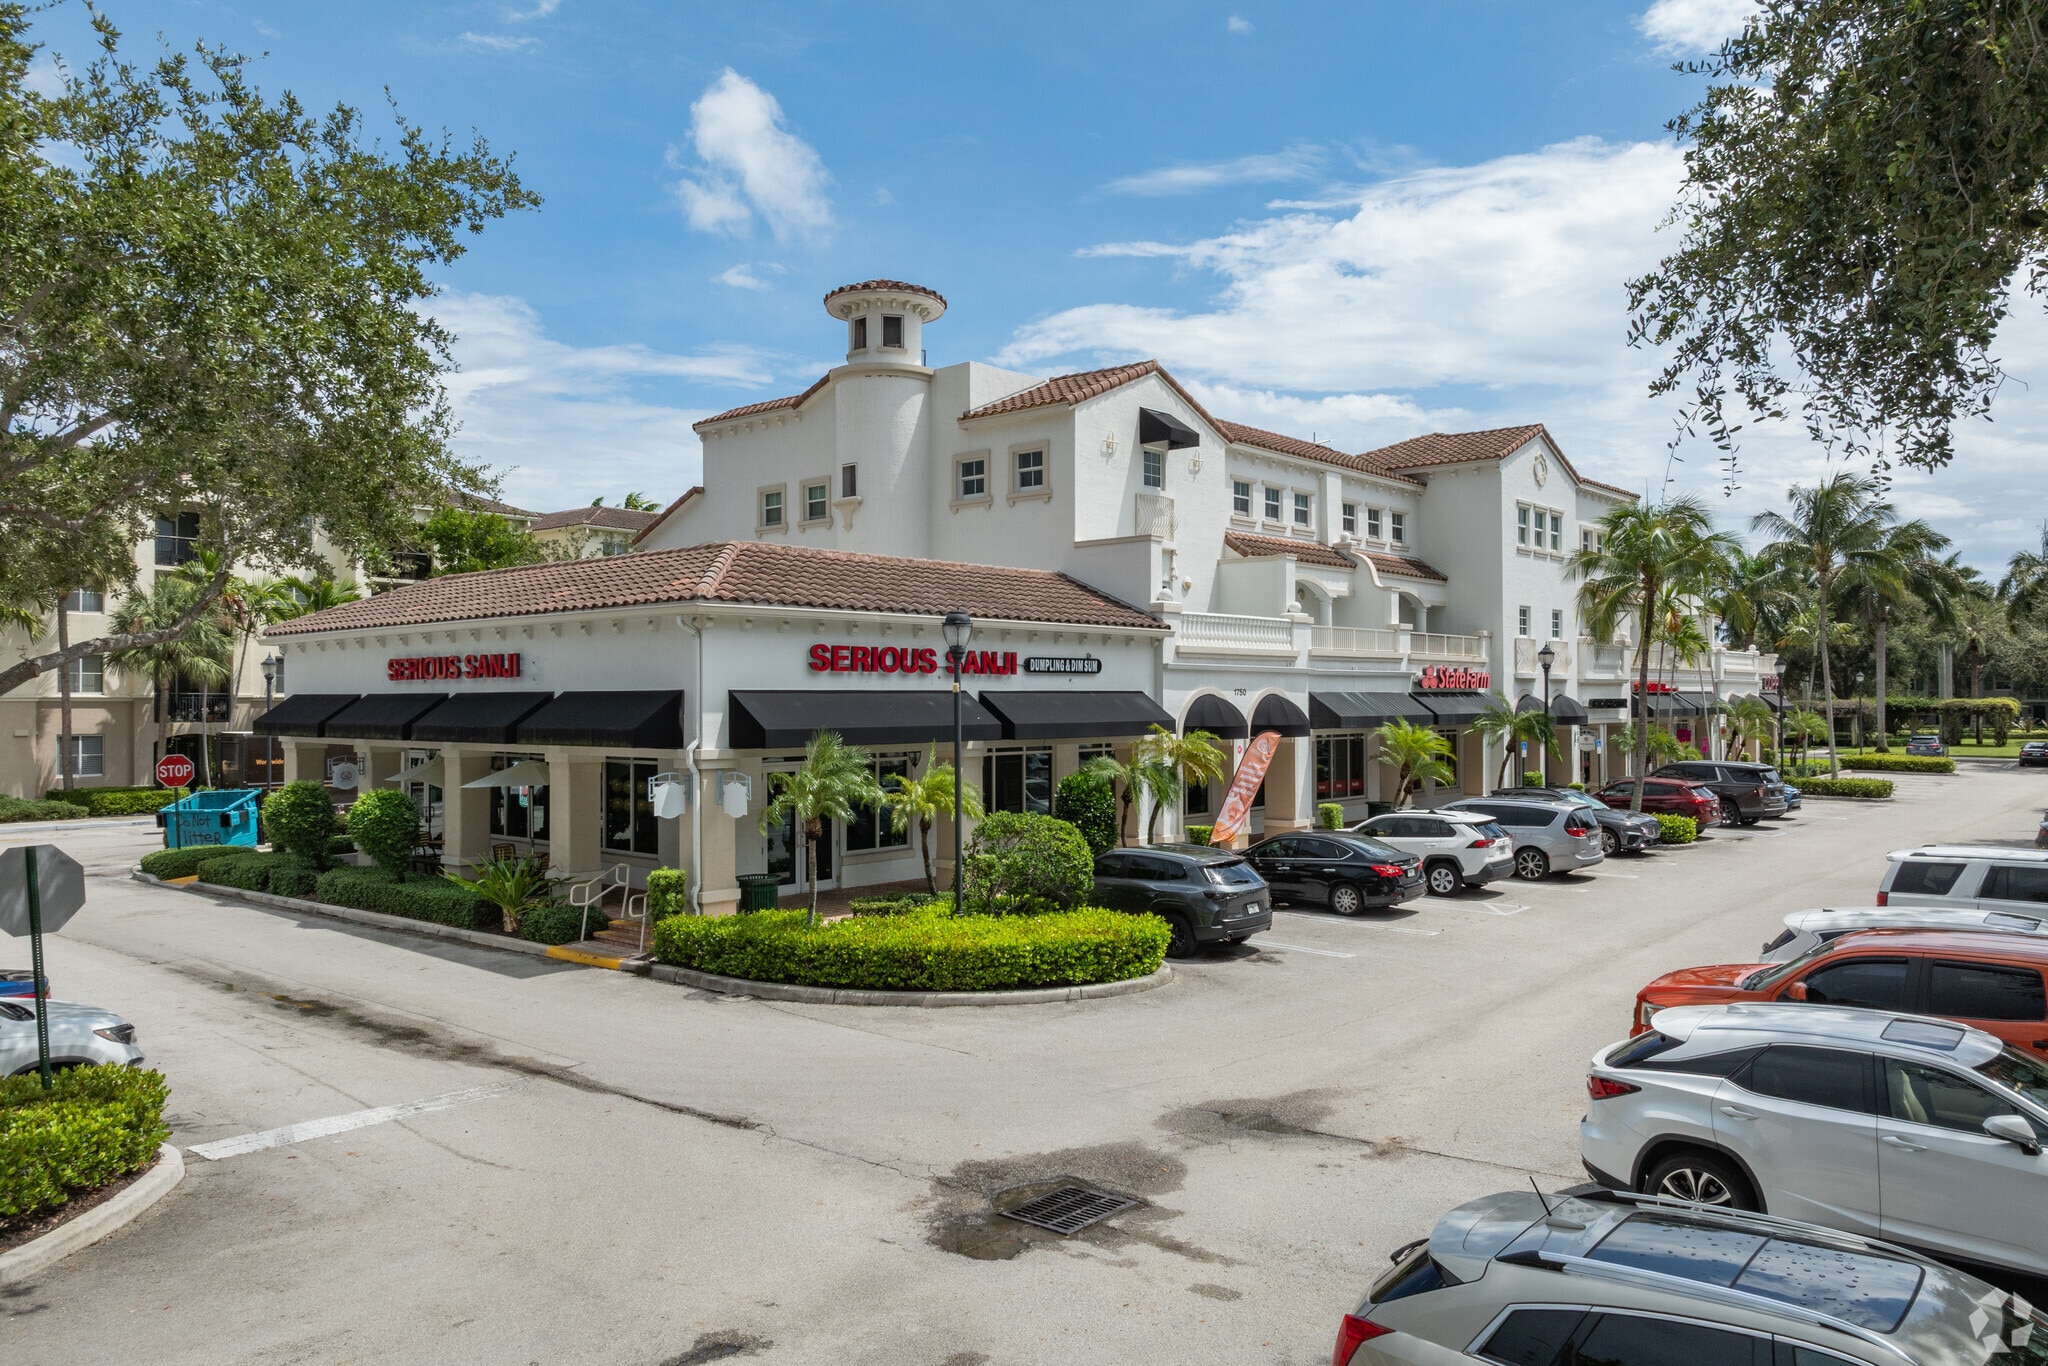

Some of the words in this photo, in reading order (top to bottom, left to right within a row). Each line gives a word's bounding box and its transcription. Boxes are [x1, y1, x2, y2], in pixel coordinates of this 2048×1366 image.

[387, 655, 461, 681] SERIOUS
[463, 652, 520, 679] SANJI
[809, 643, 938, 674] SERIOUS
[946, 650, 1018, 676] SANJI
[1030, 658, 1065, 671] DUMPLING
[1065, 659, 1071, 672] &
[1071, 659, 1083, 672] DIM
[1084, 660, 1098, 672] SUM
[1233, 688, 1247, 697] 1750
[159, 765, 191, 778] STOP
[193, 812, 212, 828] Not
